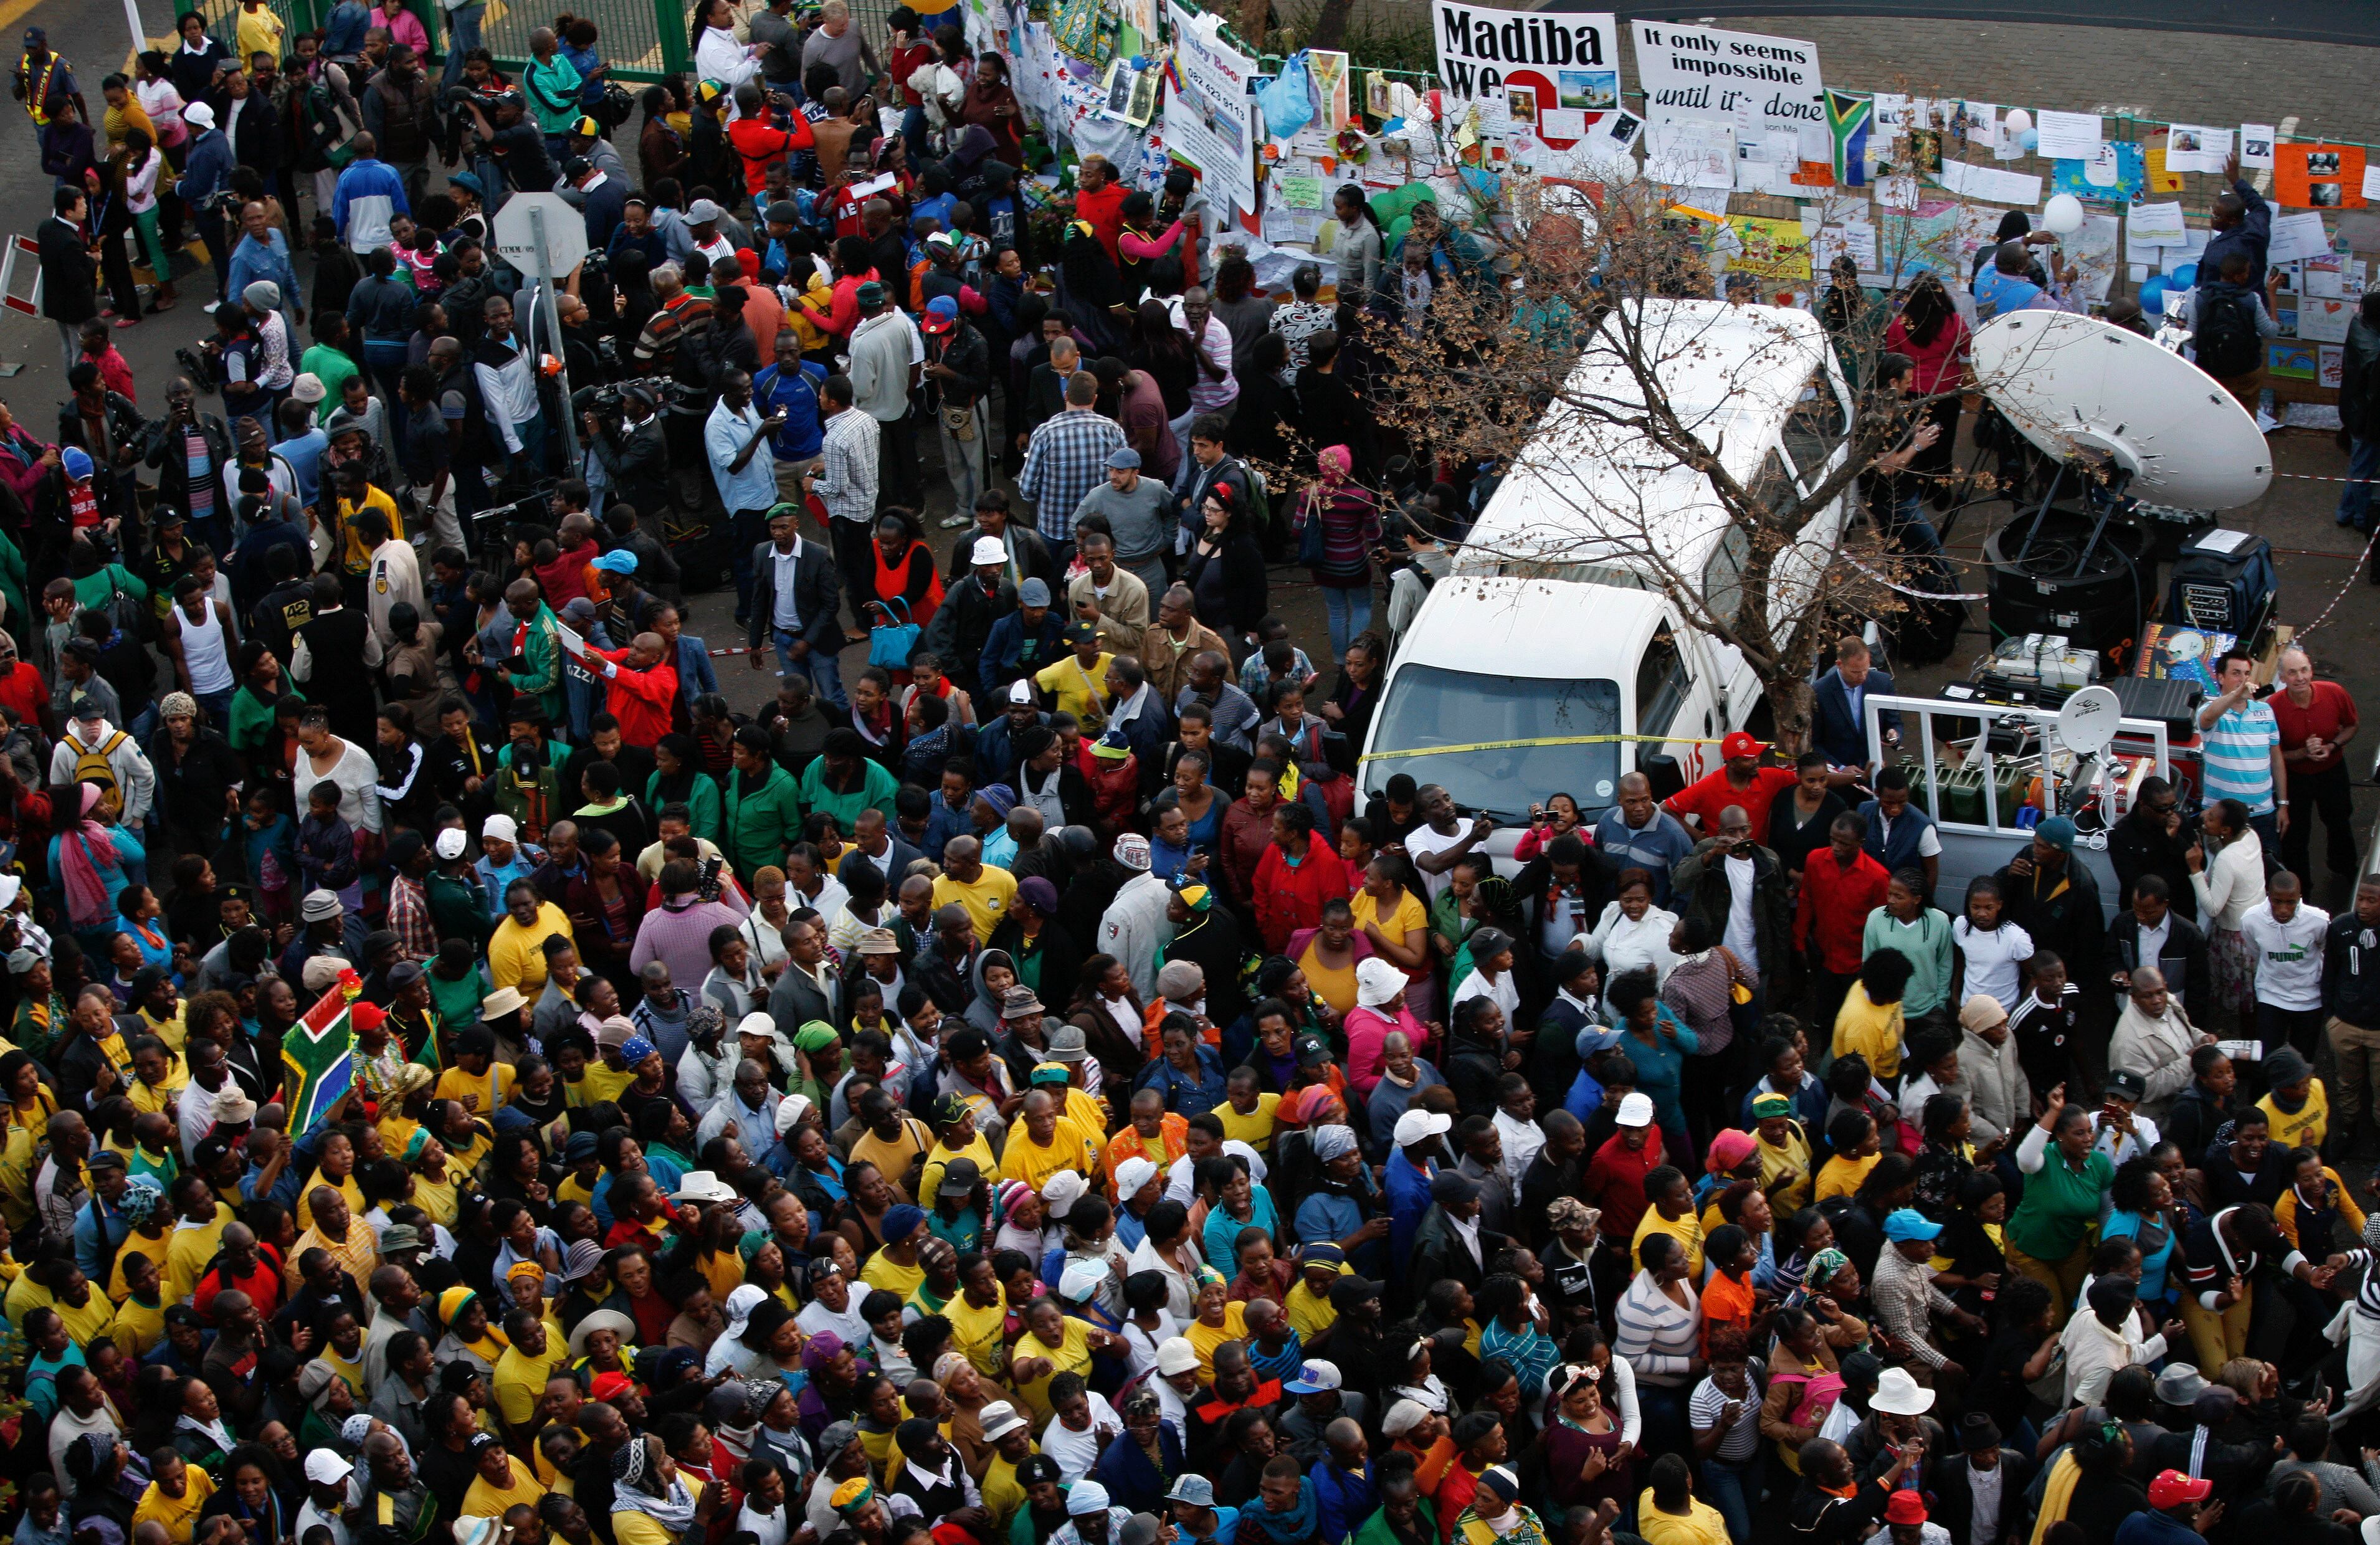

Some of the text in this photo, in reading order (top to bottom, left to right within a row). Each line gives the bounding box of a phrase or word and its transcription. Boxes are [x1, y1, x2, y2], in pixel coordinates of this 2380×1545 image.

[1183, 26, 1211, 62] Baby
[1442, 7, 1604, 66] Madiba
[1644, 27, 1807, 65] It only seems
[1444, 58, 1502, 103] We
[1672, 54, 1804, 86] impossible
[1188, 67, 1245, 121] 082 423 9113
[1655, 84, 1825, 122] until it' done
[287, 602, 310, 618] 42
[2267, 951, 2304, 963] PUMA
